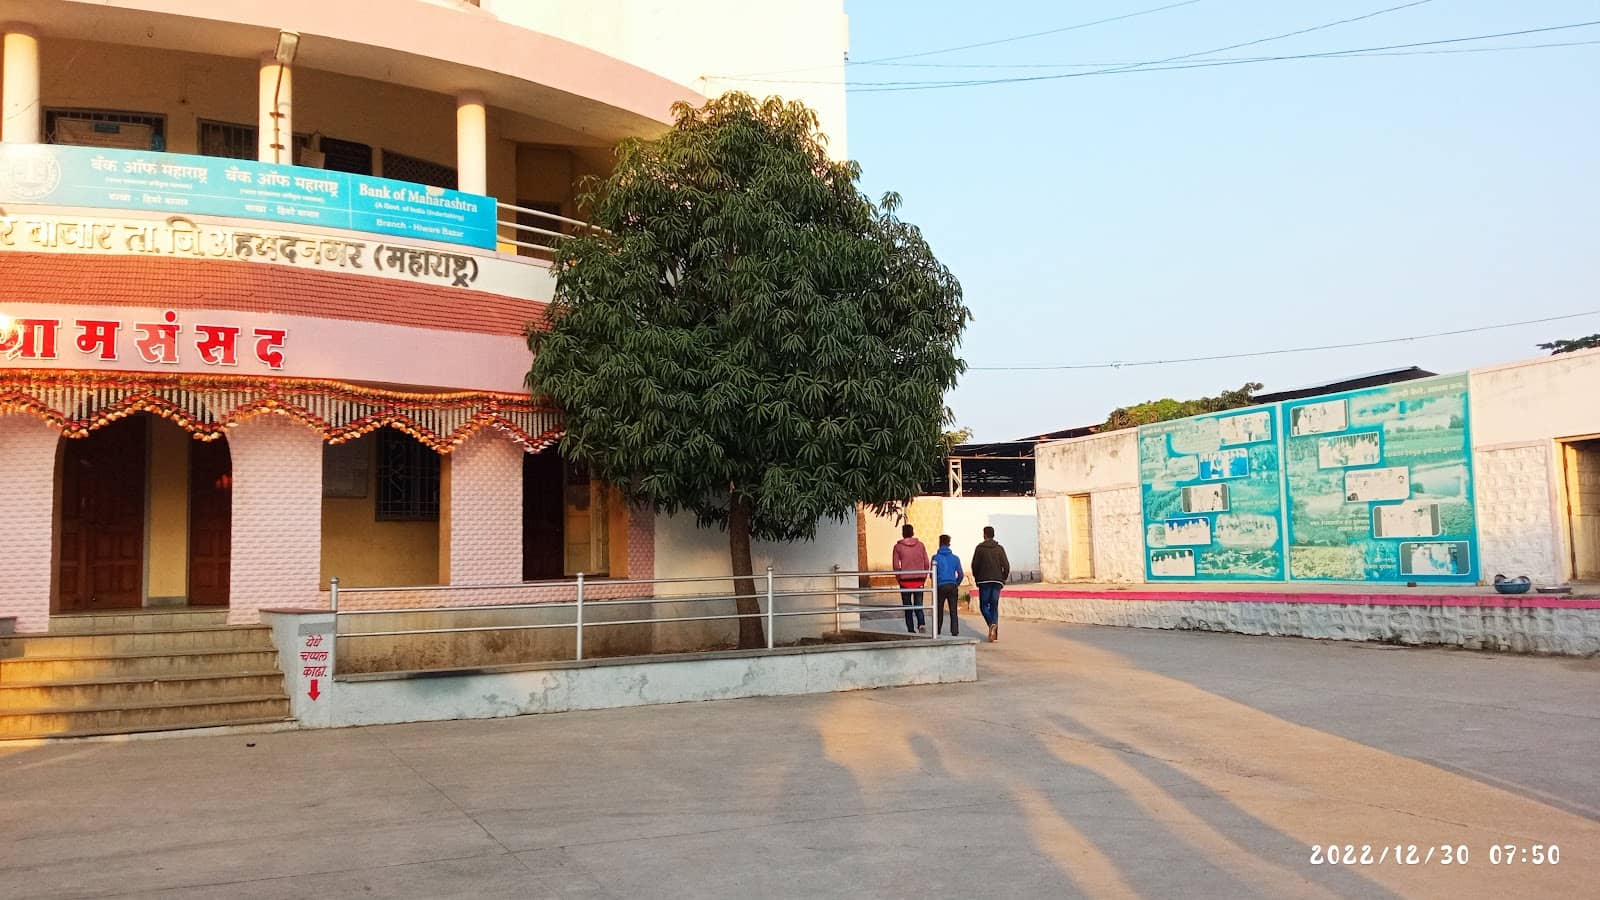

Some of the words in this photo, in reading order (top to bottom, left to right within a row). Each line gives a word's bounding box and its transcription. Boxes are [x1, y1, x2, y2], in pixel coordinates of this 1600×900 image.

[123, 159, 158, 175] ऑफ
[161, 164, 208, 184] महाराष्ट्र
[257, 170, 291, 187] ऑफ
[293, 176, 339, 198] महाराष्ट्र
[359, 183, 391, 200] Bank
[393, 188, 406, 201] of
[407, 189, 478, 213] Maharashtra
[376, 218, 407, 230] Branch
[299, 651, 329, 662] चप्पल
